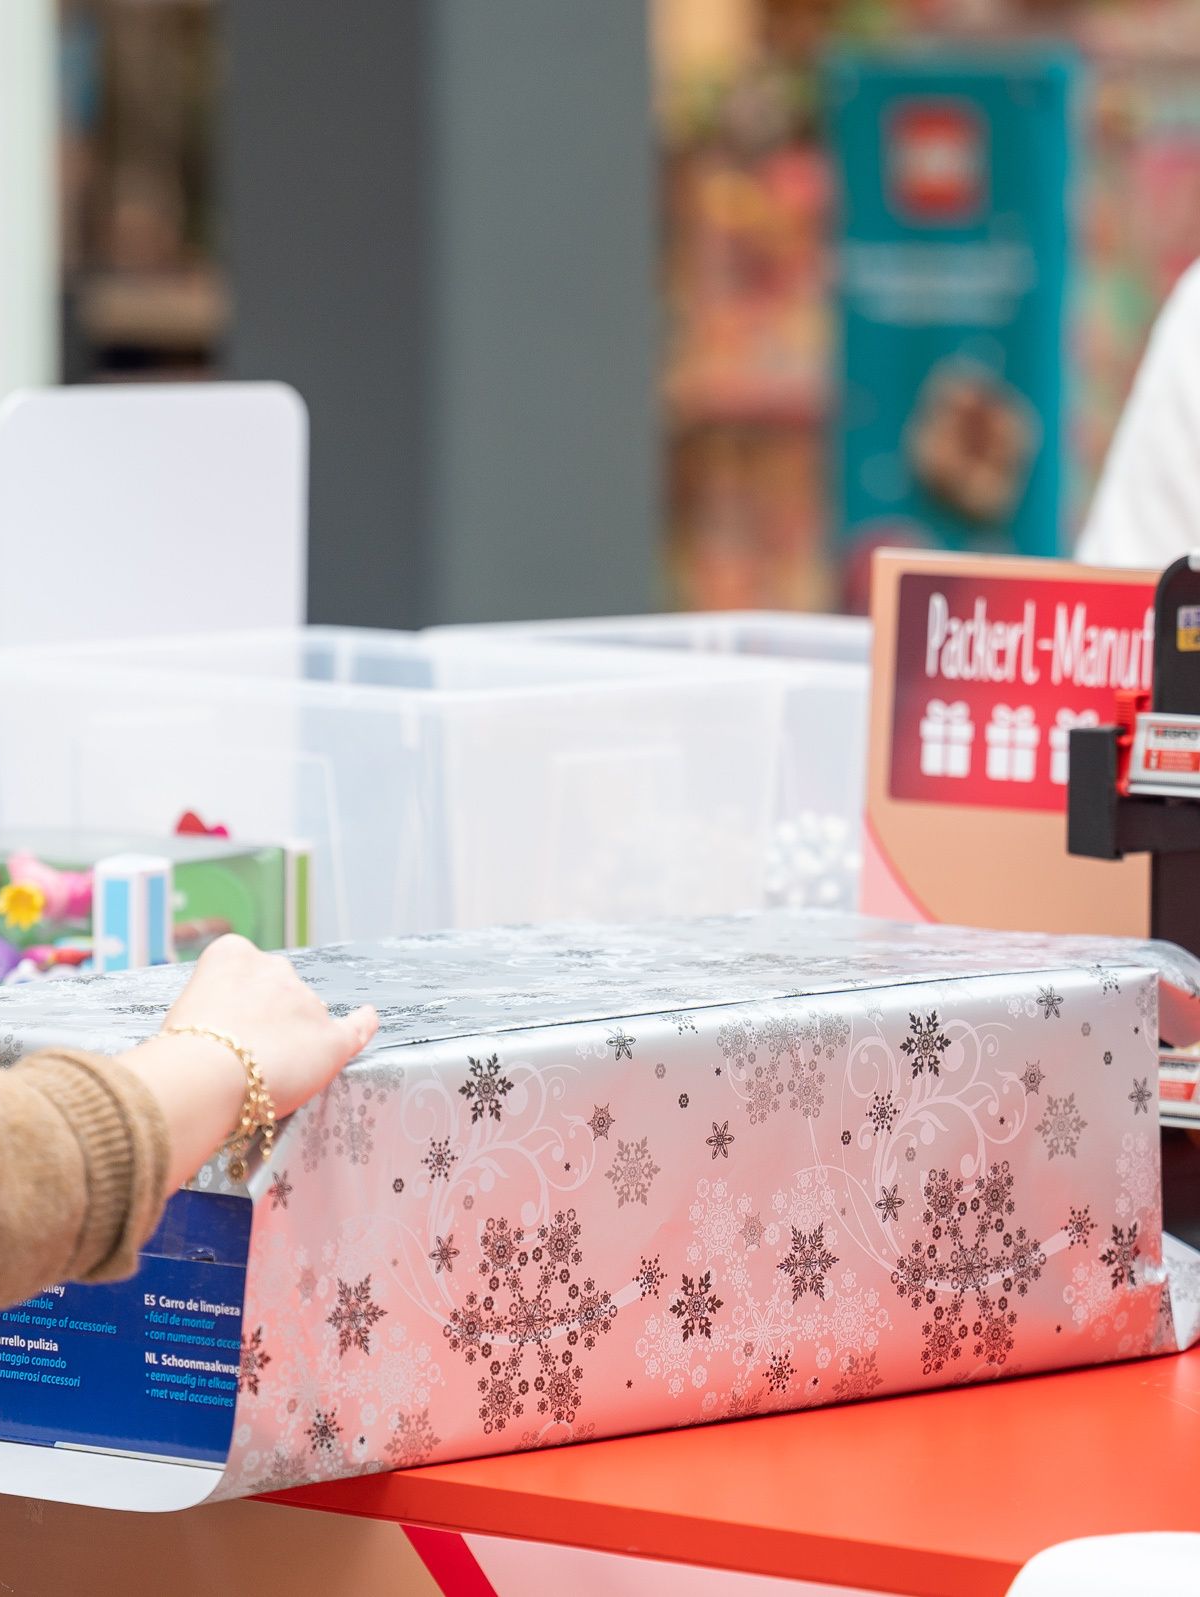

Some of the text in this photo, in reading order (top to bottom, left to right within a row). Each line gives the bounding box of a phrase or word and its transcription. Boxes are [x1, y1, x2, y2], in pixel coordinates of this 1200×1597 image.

[39, 1284, 66, 1297] olley
[144, 1293, 241, 1317] ES Carro de limpieza
[2, 1312, 9, 1321] a
[10, 1311, 30, 1324] wide
[31, 1316, 57, 1329] range
[58, 1316, 69, 1329] of
[69, 1319, 117, 1334] accessories
[149, 1311, 216, 1330] fácil de montar
[27, 1337, 59, 1352] pulizia
[149, 1330, 166, 1340] con
[167, 1332, 216, 1347] numerosos
[31, 1355, 67, 1369] comodo
[144, 1351, 241, 1378] NL Schoonmaakwag
[0, 1368, 40, 1383] numerosi
[41, 1373, 81, 1388] accessori
[150, 1371, 237, 1391] eenvoudig in elkaar
[150, 1388, 234, 1408] met veel accesoires
